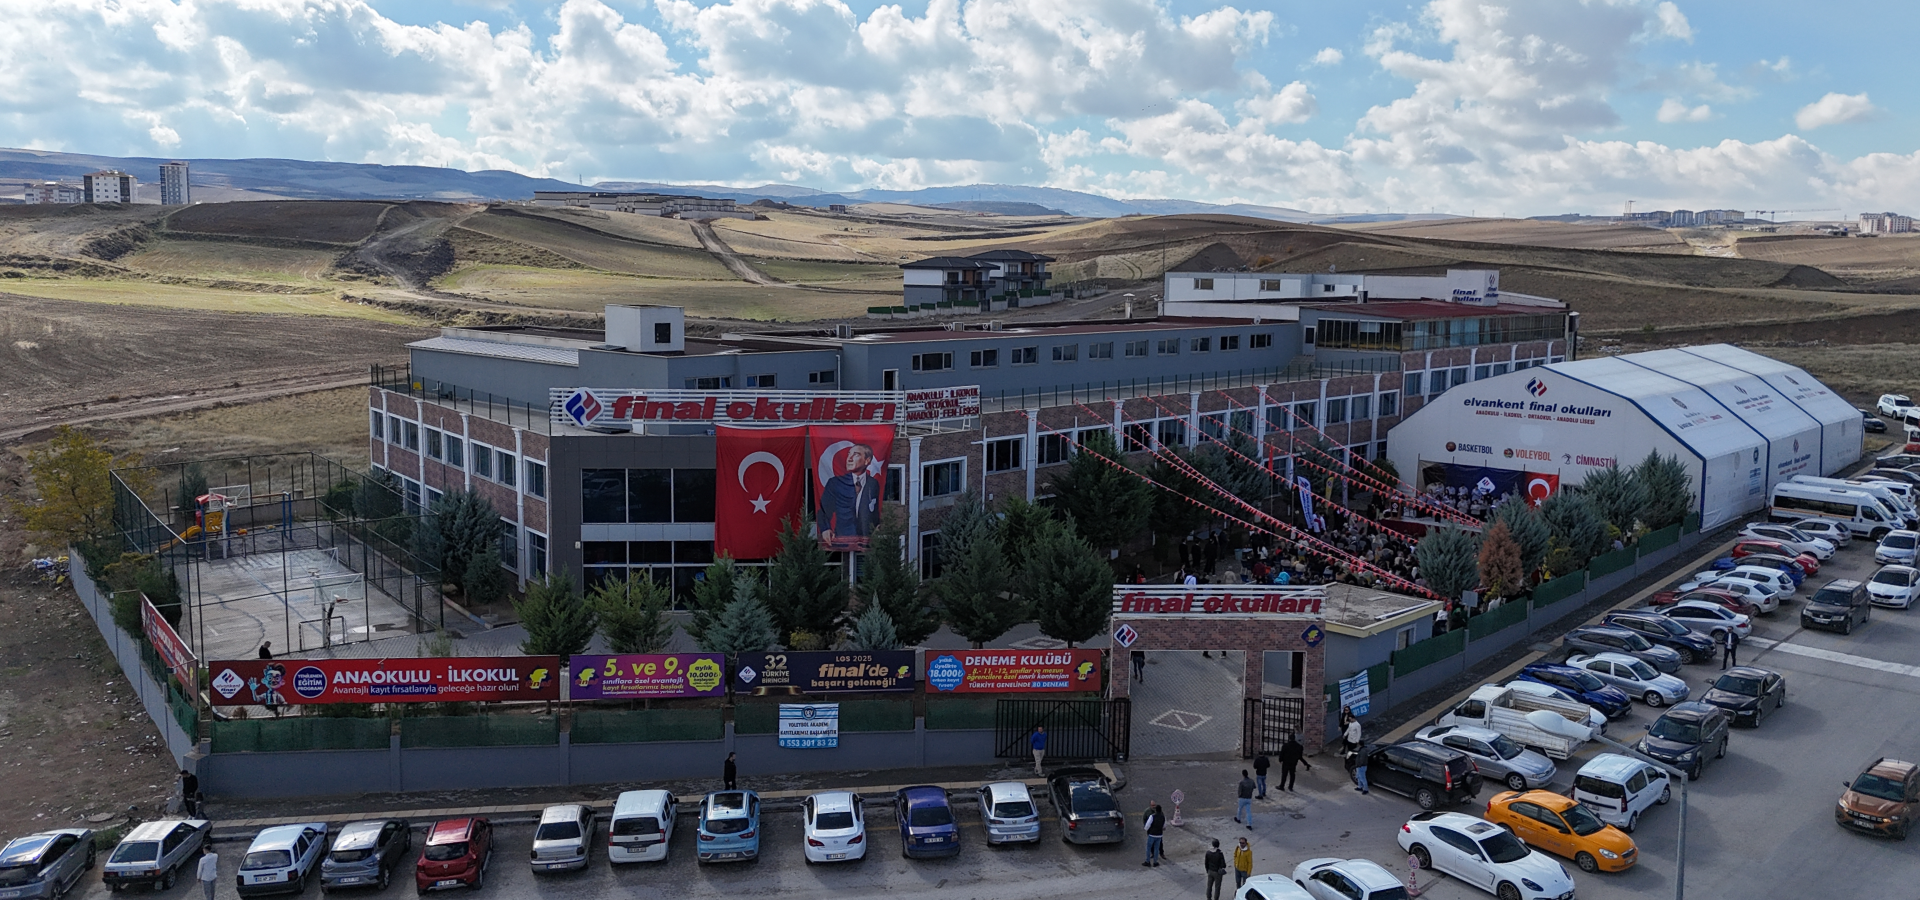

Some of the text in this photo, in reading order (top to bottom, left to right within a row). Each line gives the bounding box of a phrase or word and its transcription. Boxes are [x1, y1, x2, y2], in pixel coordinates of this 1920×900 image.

[612, 396, 896, 421] final okulları
[1464, 398, 1612, 417] elvankent final okulları
[1458, 443, 1493, 455] BASKETBOL
[1515, 449, 1552, 461] VOLEYBOL
[1121, 592, 1321, 613] final okulları
[604, 657, 683, 677] 5. ve 9.
[765, 655, 788, 670] 32
[965, 653, 1072, 666] DENEME KULÜBÜ
[333, 670, 430, 684] ANAOKULU
[448, 665, 520, 682] İLKOKUL
[819, 663, 889, 678] final'de
[651, 677, 684, 685] avantajlı
[812, 678, 896, 689] başarı geleneği!
[333, 686, 368, 695] Avantajlı
[370, 686, 390, 695] kayıt
[392, 685, 437, 694] fırsatlarıyla
[438, 684, 475, 694] geleceğe
